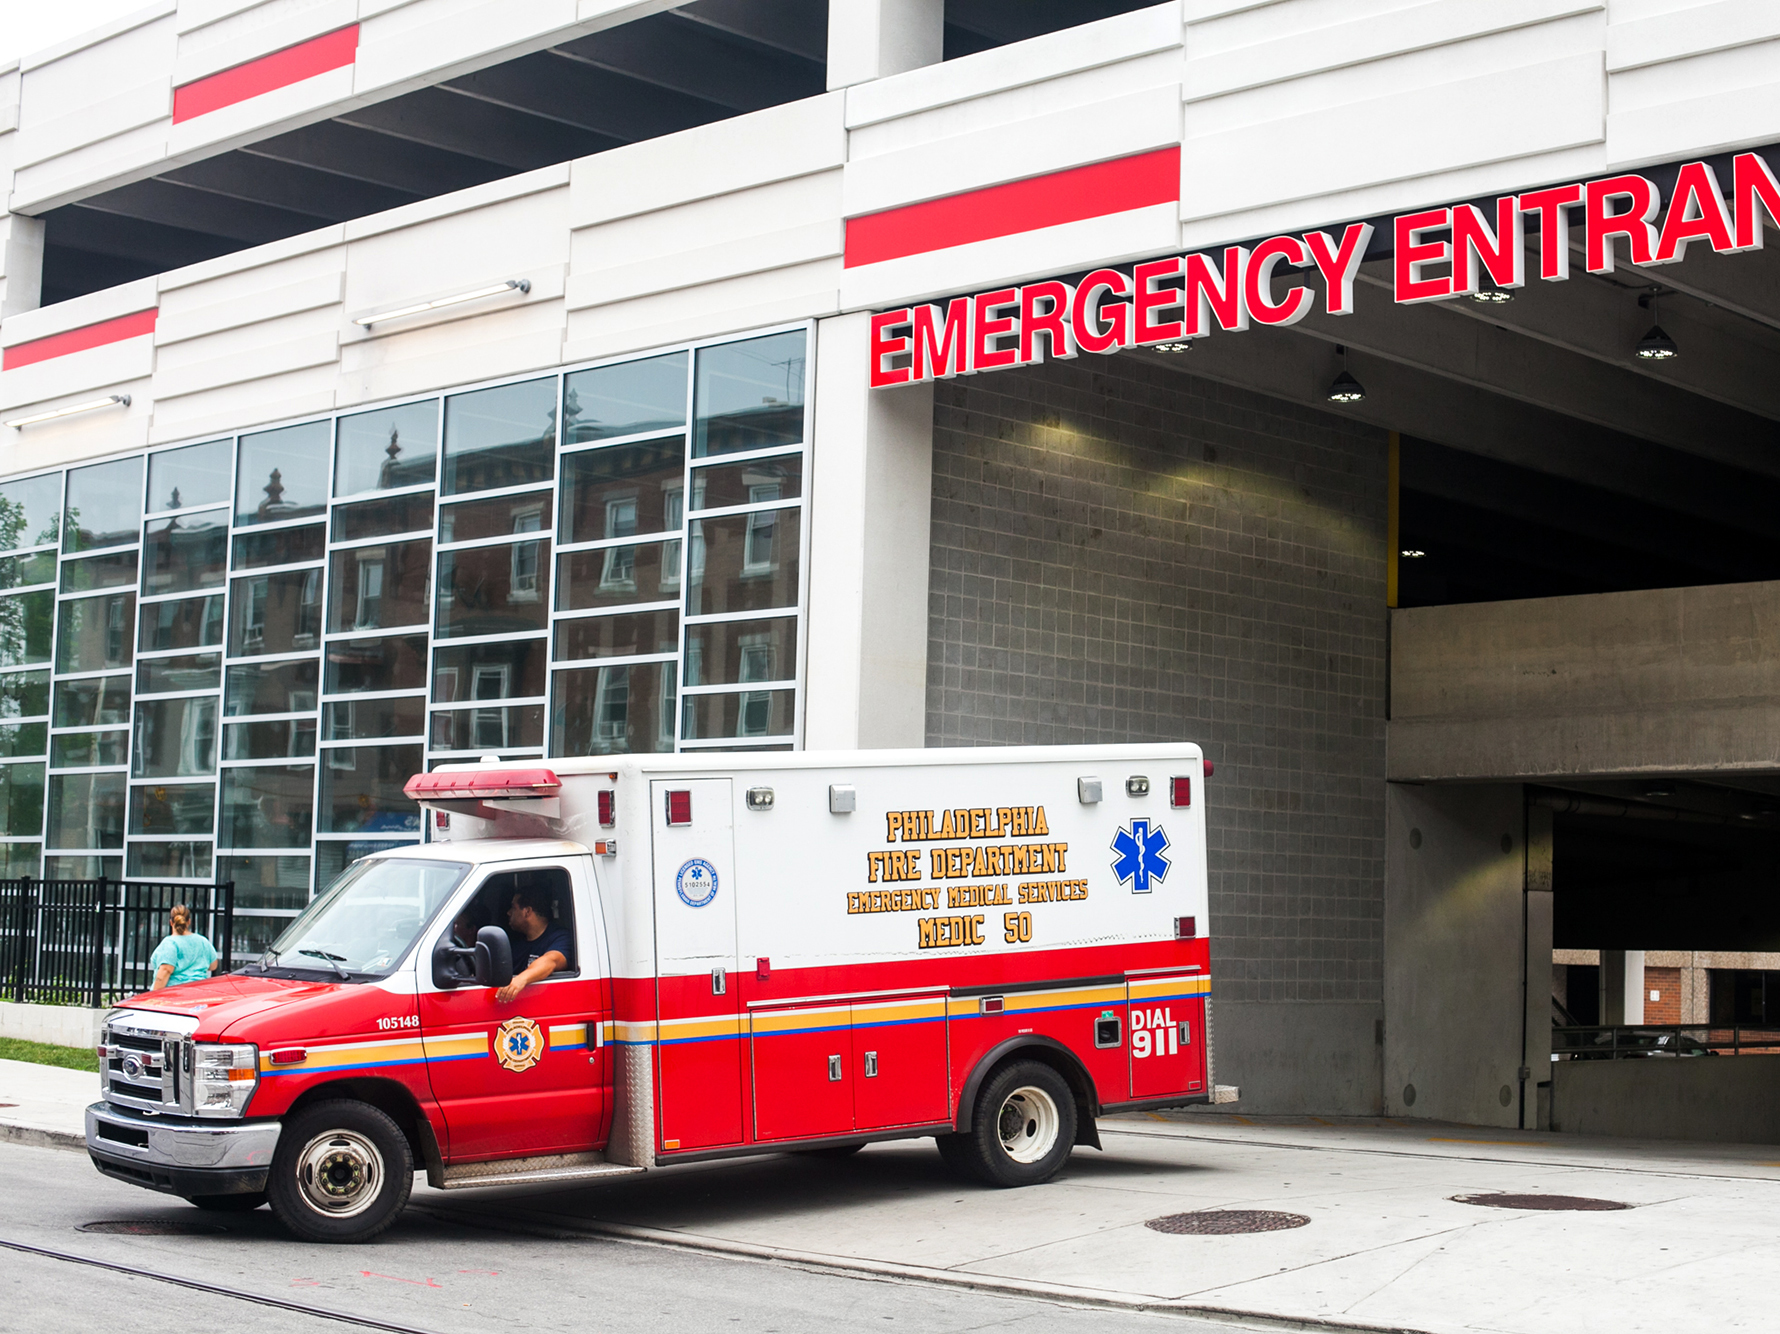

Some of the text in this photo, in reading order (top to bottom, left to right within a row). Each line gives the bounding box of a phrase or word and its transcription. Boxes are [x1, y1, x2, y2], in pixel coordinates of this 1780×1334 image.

[869, 222, 1374, 389] EMERGENCY
[886, 806, 1050, 843] PHILADELPHIA
[867, 842, 1069, 883] FIRE DEPARTMENT
[847, 878, 1089, 915] EMERGENCY MEDICAL SERVICES
[918, 911, 1033, 949] MEDIC 50
[376, 1014, 420, 1030] 105148
[1131, 1007, 1177, 1031] DIAL
[1132, 1027, 1178, 1059] 911
